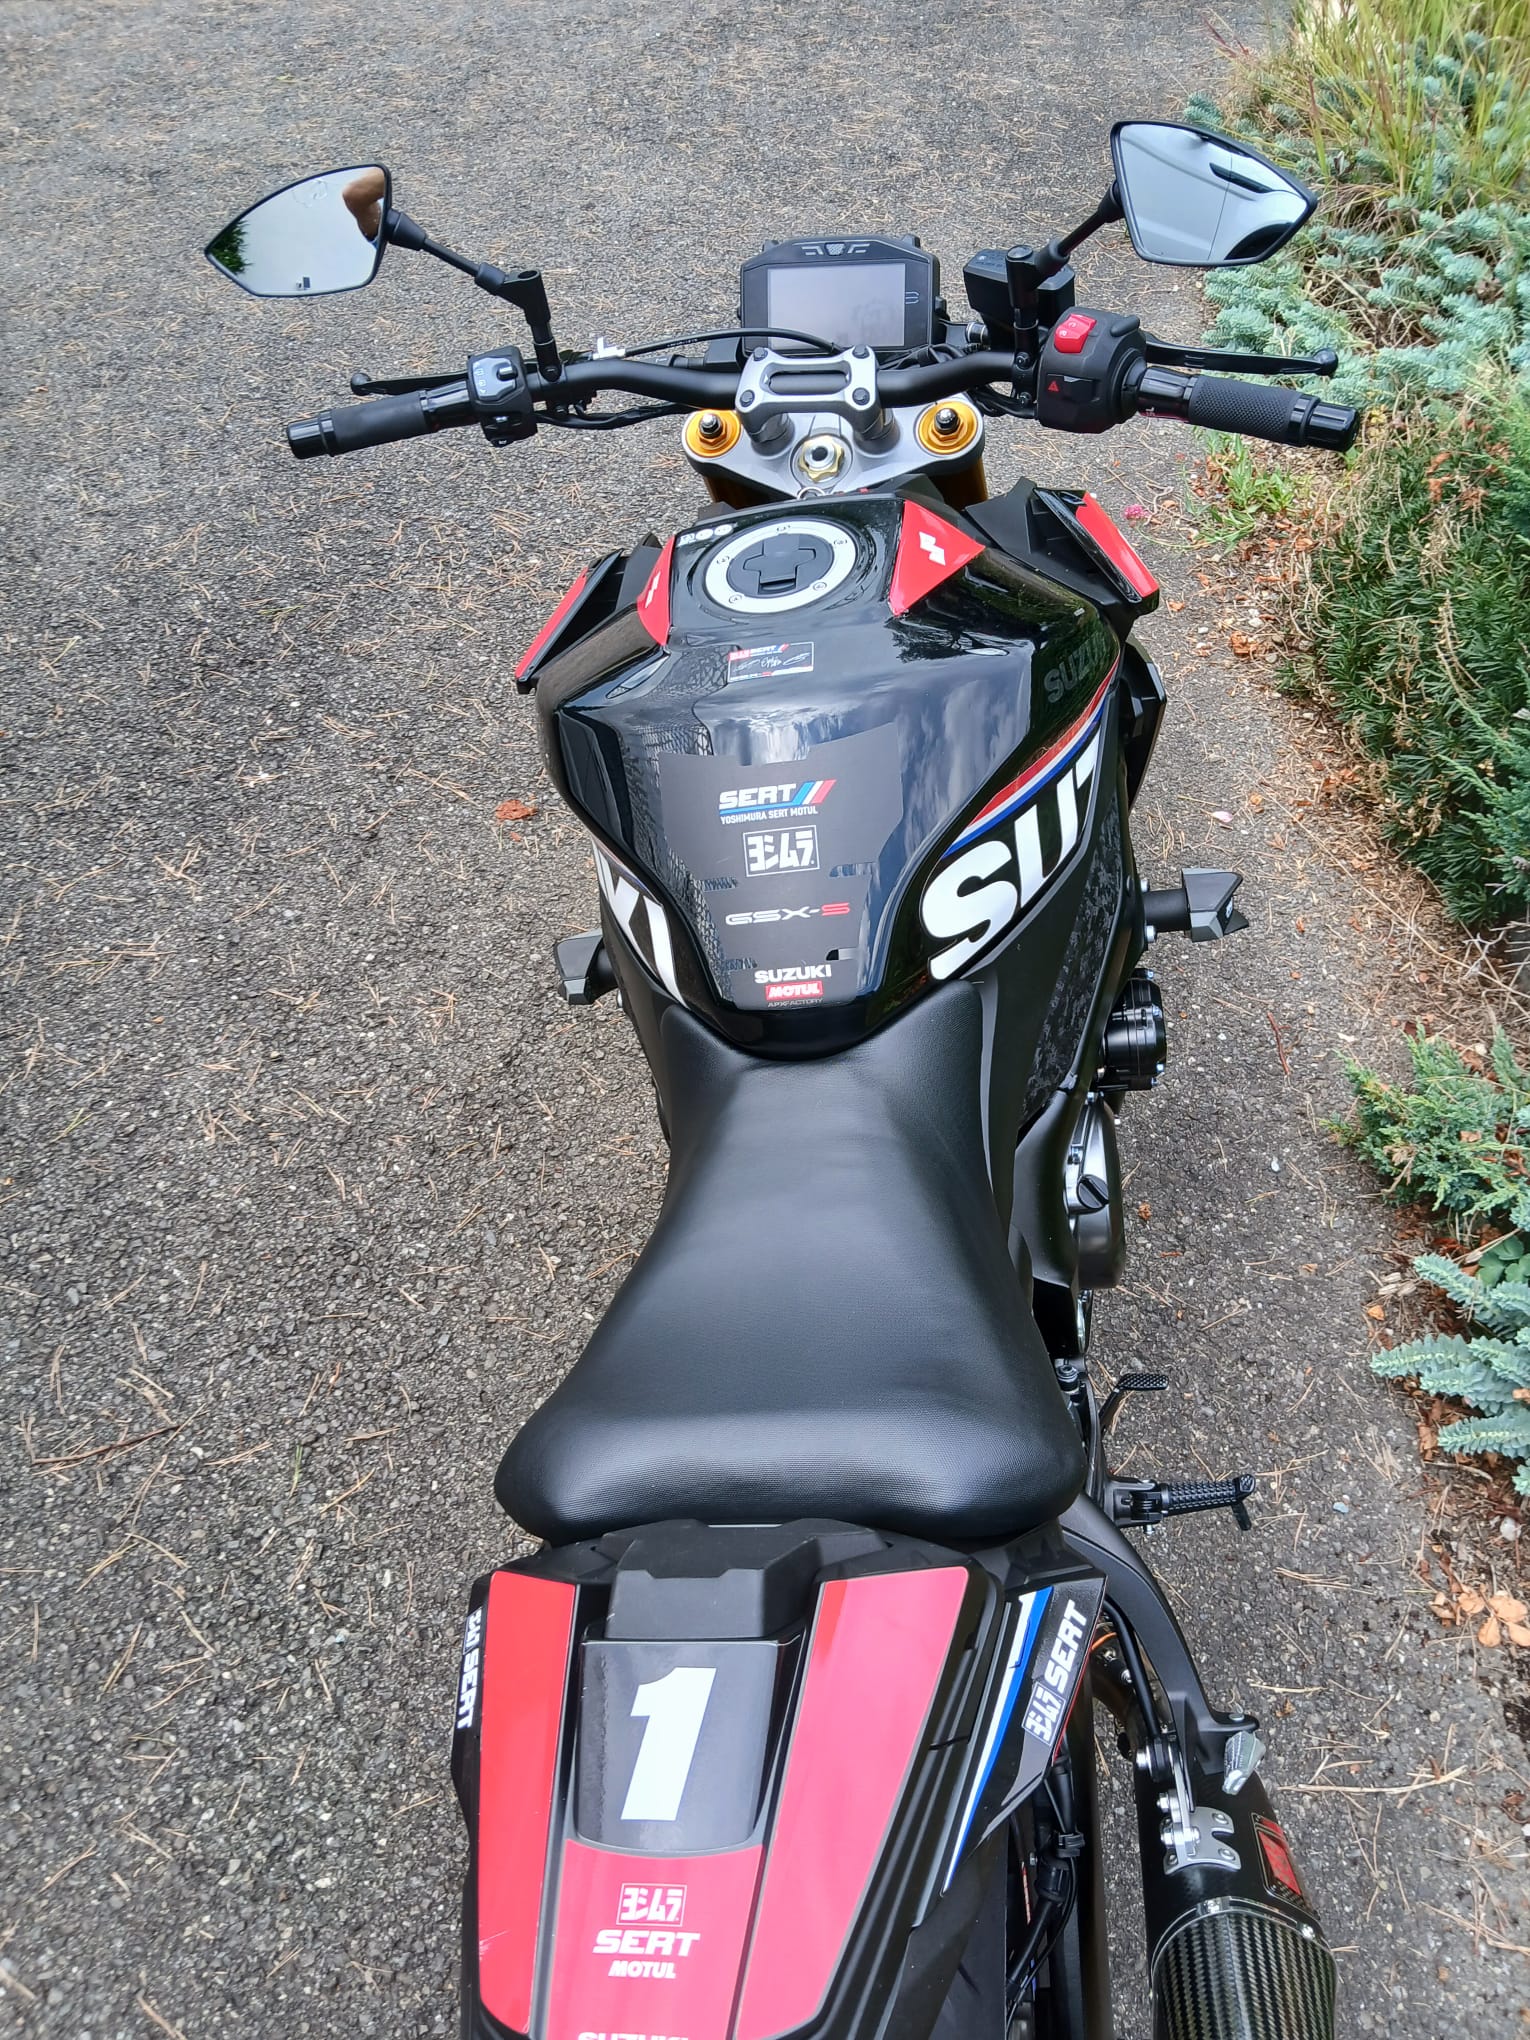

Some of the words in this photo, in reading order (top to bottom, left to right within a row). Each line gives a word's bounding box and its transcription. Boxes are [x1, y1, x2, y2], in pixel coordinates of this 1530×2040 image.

[718, 783, 797, 810] SERT
[720, 812, 767, 825] YOSHIMURA
[768, 808, 788, 819] SERT
[790, 805, 818, 817] MOTUL
[725, 902, 850, 926] GSX-S
[754, 964, 832, 984] SUZUKI
[768, 983, 820, 998] MOTUL
[1044, 1599, 1087, 1694] SERT
[457, 1647, 480, 1729] SERT
[620, 1666, 717, 1821] 1
[592, 1929, 701, 1957] SERT
[608, 1960, 677, 1979] MOTUL
